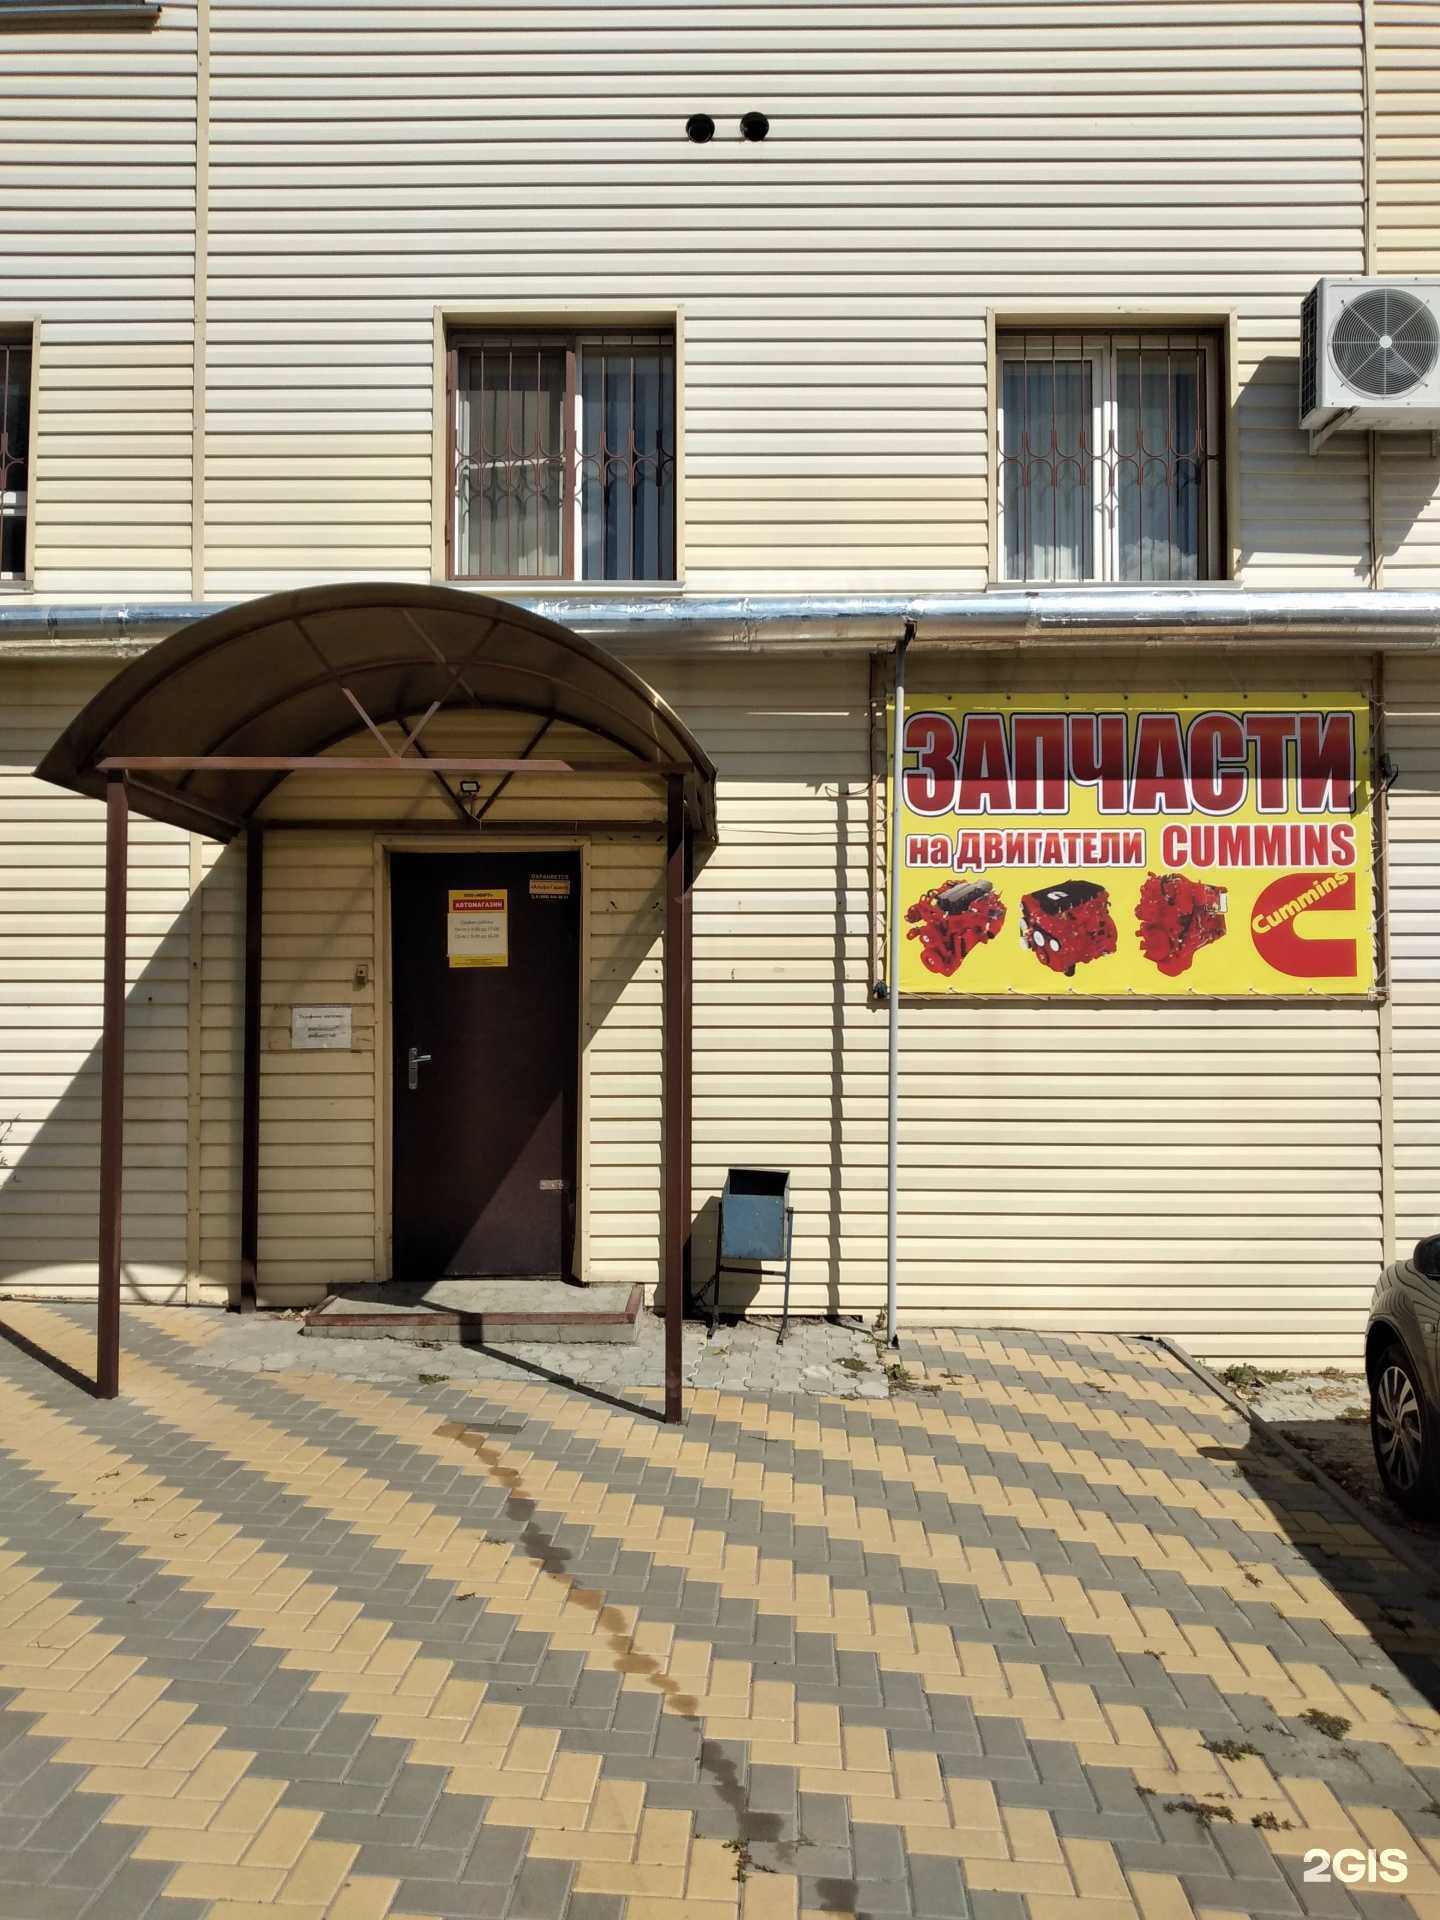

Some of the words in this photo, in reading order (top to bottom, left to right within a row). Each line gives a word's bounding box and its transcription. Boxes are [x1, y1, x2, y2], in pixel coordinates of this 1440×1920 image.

[903, 712, 1357, 815] ЗАПЧАСТИ
[907, 834, 951, 866] на
[956, 829, 1144, 870] ДВИГАТЕЛИ
[1162, 823, 1356, 868] CUMMINS
[455, 901, 503, 909] АВТОМАГАЗИН
[1251, 870, 1350, 935] Cummins
